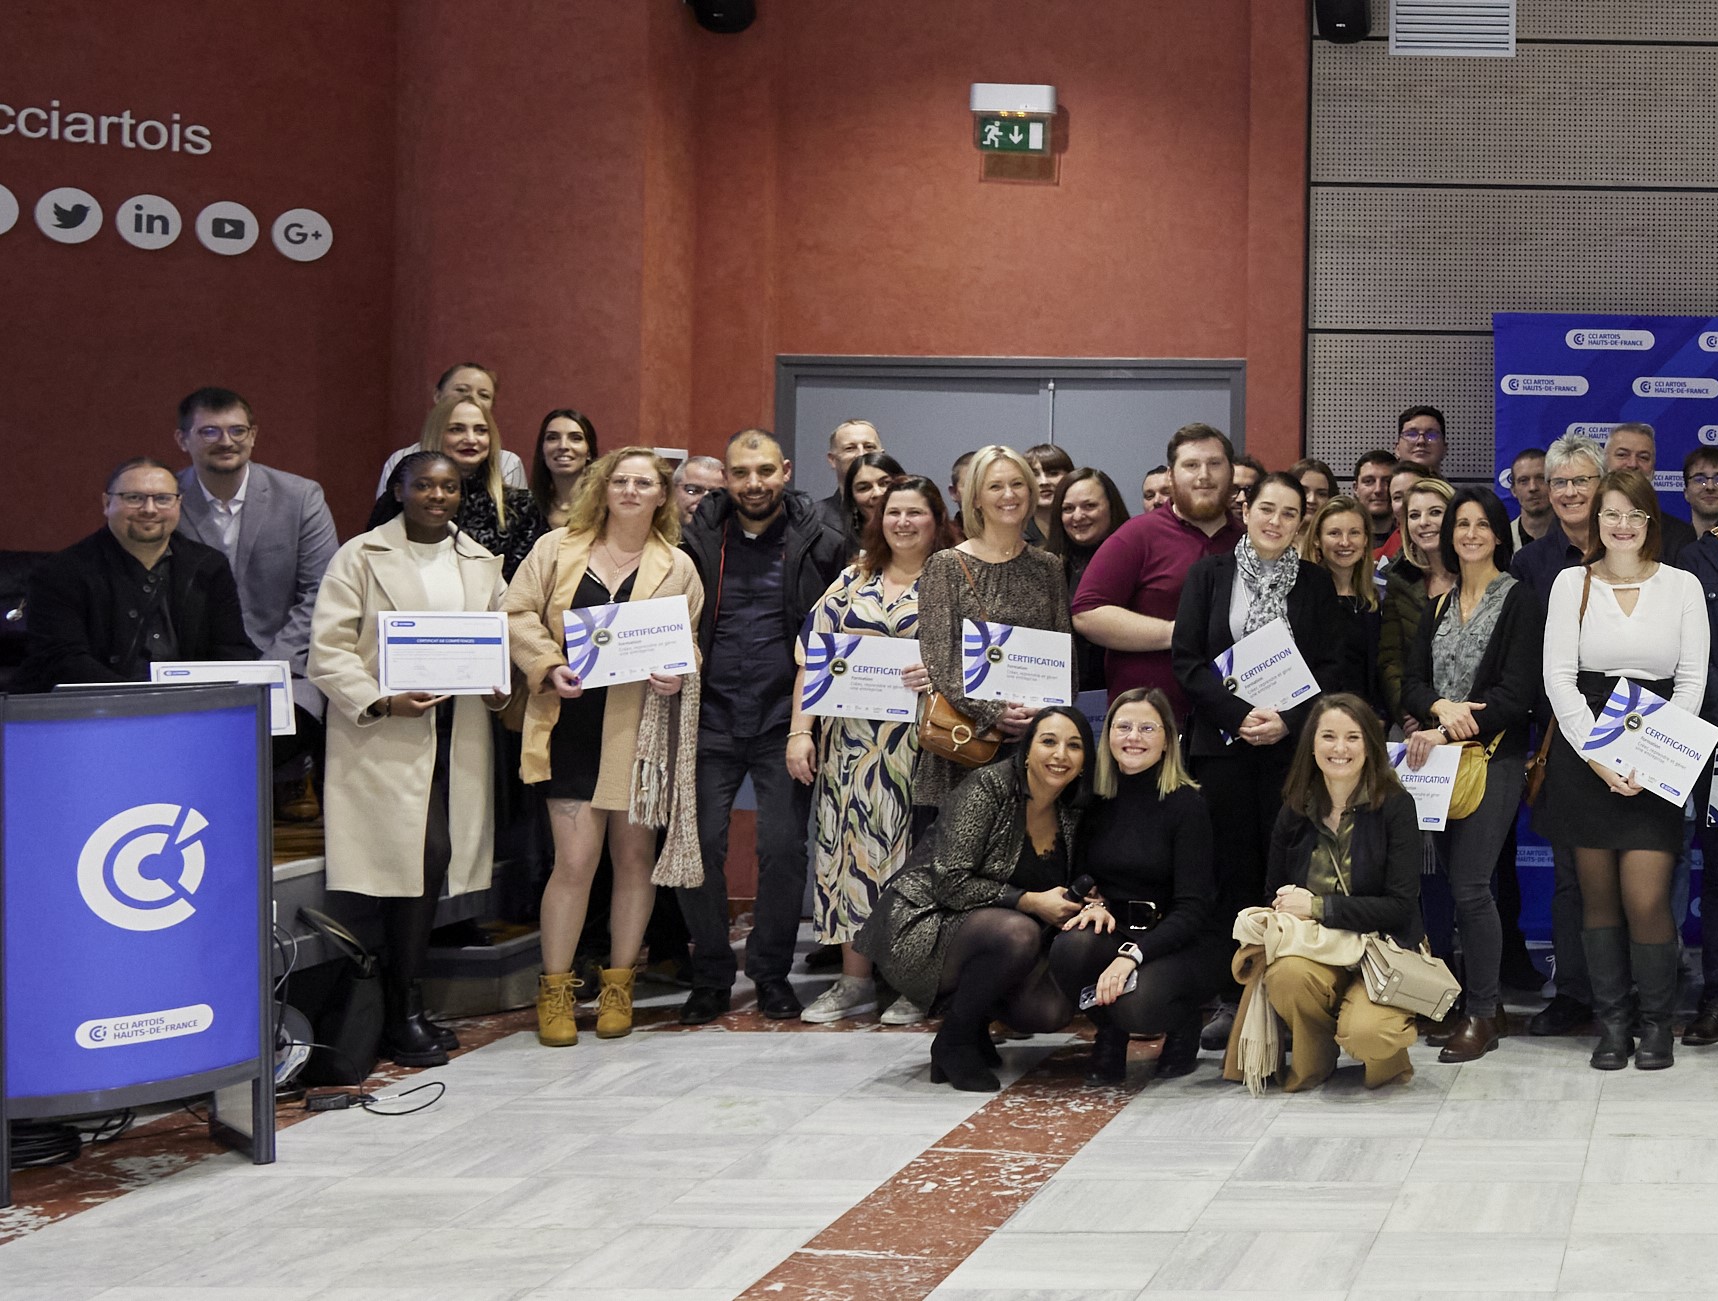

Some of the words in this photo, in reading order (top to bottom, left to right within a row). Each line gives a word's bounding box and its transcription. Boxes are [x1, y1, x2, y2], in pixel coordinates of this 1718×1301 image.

[1587, 332, 1598, 340] CCI
[1598, 332, 1621, 340] ARTOIS
[1587, 339, 1644, 347] HAUTS-DE-FRANCE
[1522, 378, 1533, 386] CCI
[1533, 378, 1556, 386] ARTOIS
[1654, 380, 1665, 388] CCI
[1665, 380, 1688, 388] ARTOIS
[1522, 384, 1579, 392] HAUTS-DE-FRANCE
[1654, 387, 1711, 395] HAUTS-DE-FRANCE
[617, 623, 683, 639] CERTIFICATION
[1008, 653, 1065, 668] CERTIFICATION
[1240, 647, 1292, 682] CERTIFICATION
[852, 665, 904, 676] CERTIFICATI
[1645, 726, 1702, 761] CERTIFICATION
[1401, 775, 1450, 784] CERTIFICATION
[113, 1022, 129, 1031] CCI
[131, 1017, 165, 1028] ARTOIS
[113, 1020, 198, 1039] HAUTS-DE-FRANCE
